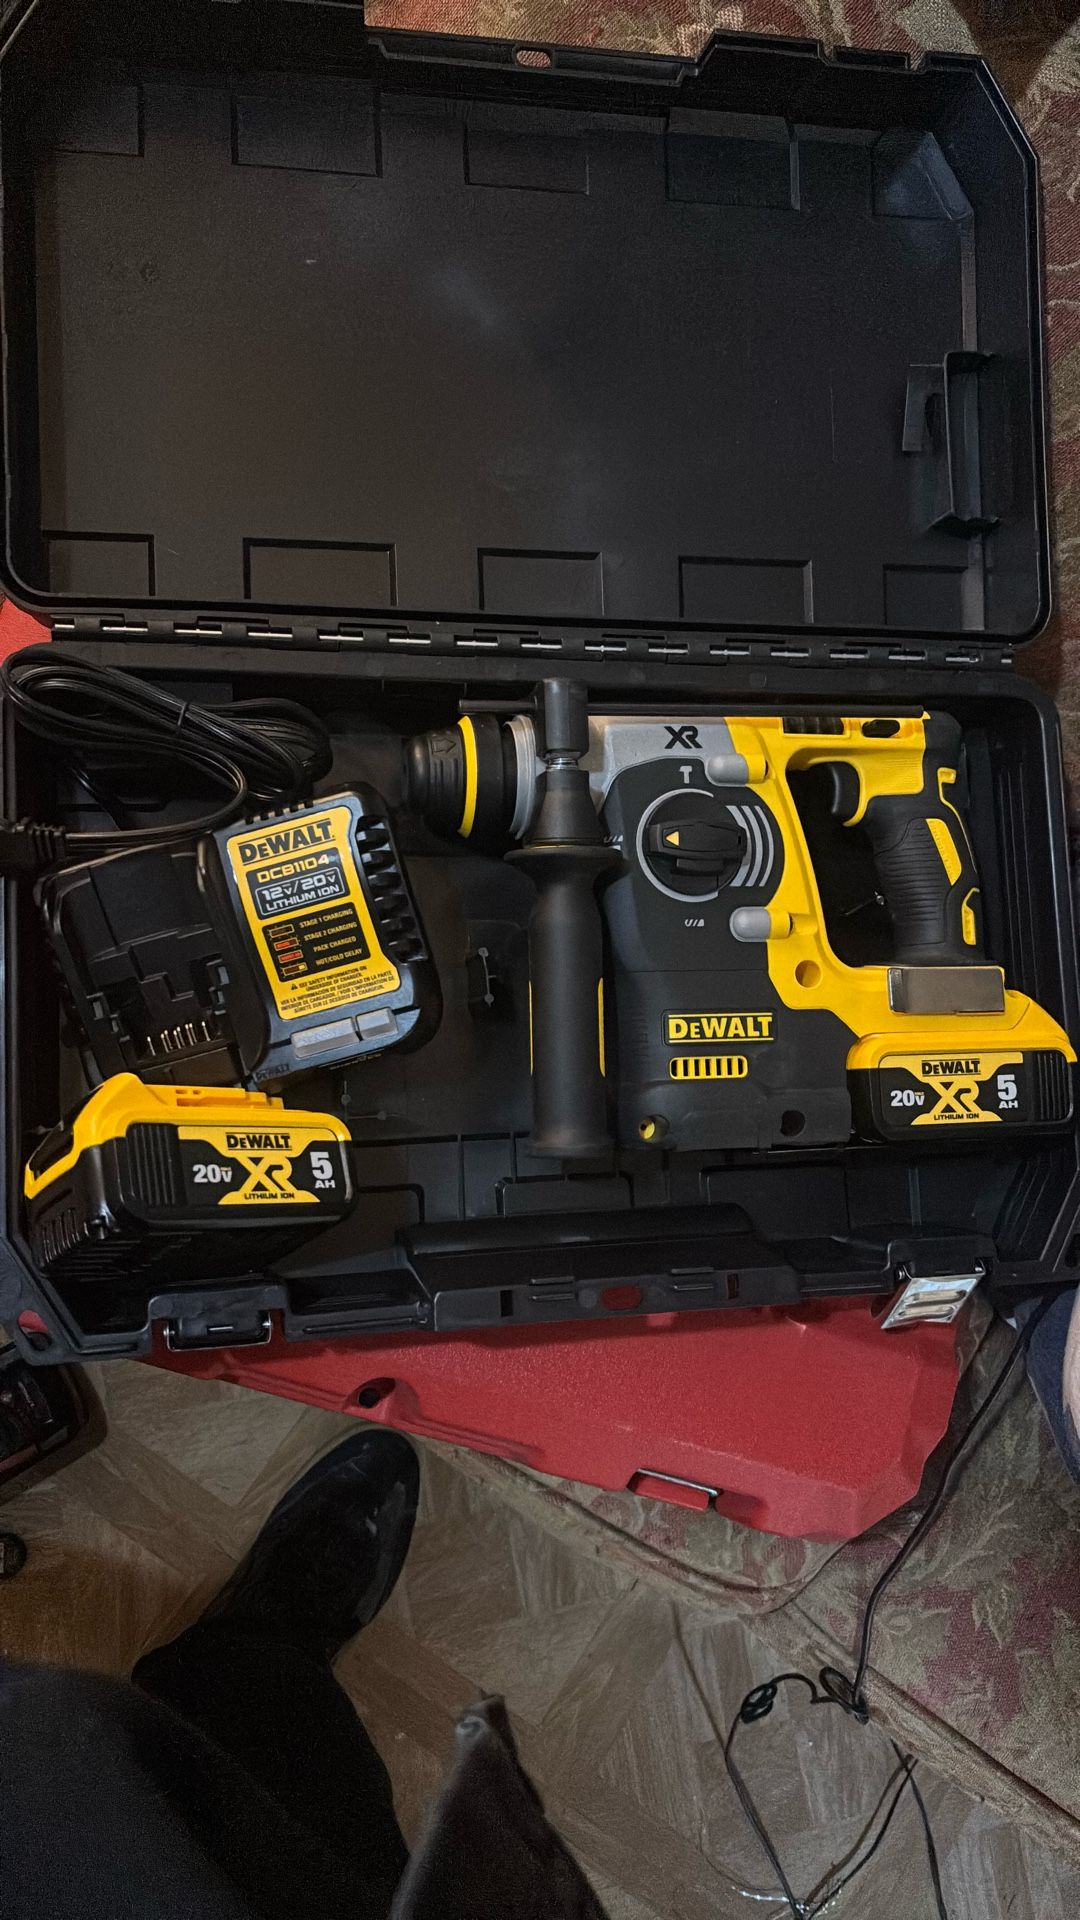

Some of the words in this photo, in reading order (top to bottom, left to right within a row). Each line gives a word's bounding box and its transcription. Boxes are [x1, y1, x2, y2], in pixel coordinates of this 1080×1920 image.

[664, 725, 703, 749] XR
[239, 821, 332, 863] DEWALT
[256, 853, 329, 884] DCB1104
[267, 891, 317, 911] LITHIUM
[318, 884, 340, 896] ION
[300, 918, 317, 928] STAGE
[323, 909, 353, 922] CHARGING
[304, 931, 321, 941] STAGE
[327, 922, 357, 935] CHARGING
[313, 944, 329, 952] PACK
[329, 936, 356, 948] CHARGED
[316, 953, 344, 966] HOT/COLD
[344, 948, 362, 957] DELAY
[309, 977, 326, 985] SAFETY
[326, 968, 359, 980] INFORMATION
[306, 981, 333, 992] UNDERSIDE
[668, 1017, 772, 1038] DEWALT
[922, 1060, 980, 1075] DEWALT
[997, 1074, 1017, 1100] 5
[928, 1080, 982, 1114] XR
[999, 1100, 1018, 1109] AH
[226, 1134, 291, 1149] DEWALT
[235, 1157, 298, 1192] XR
[310, 1151, 333, 1180] 5
[315, 1179, 336, 1189] AH
[244, 1192, 278, 1200] LITHIUM
